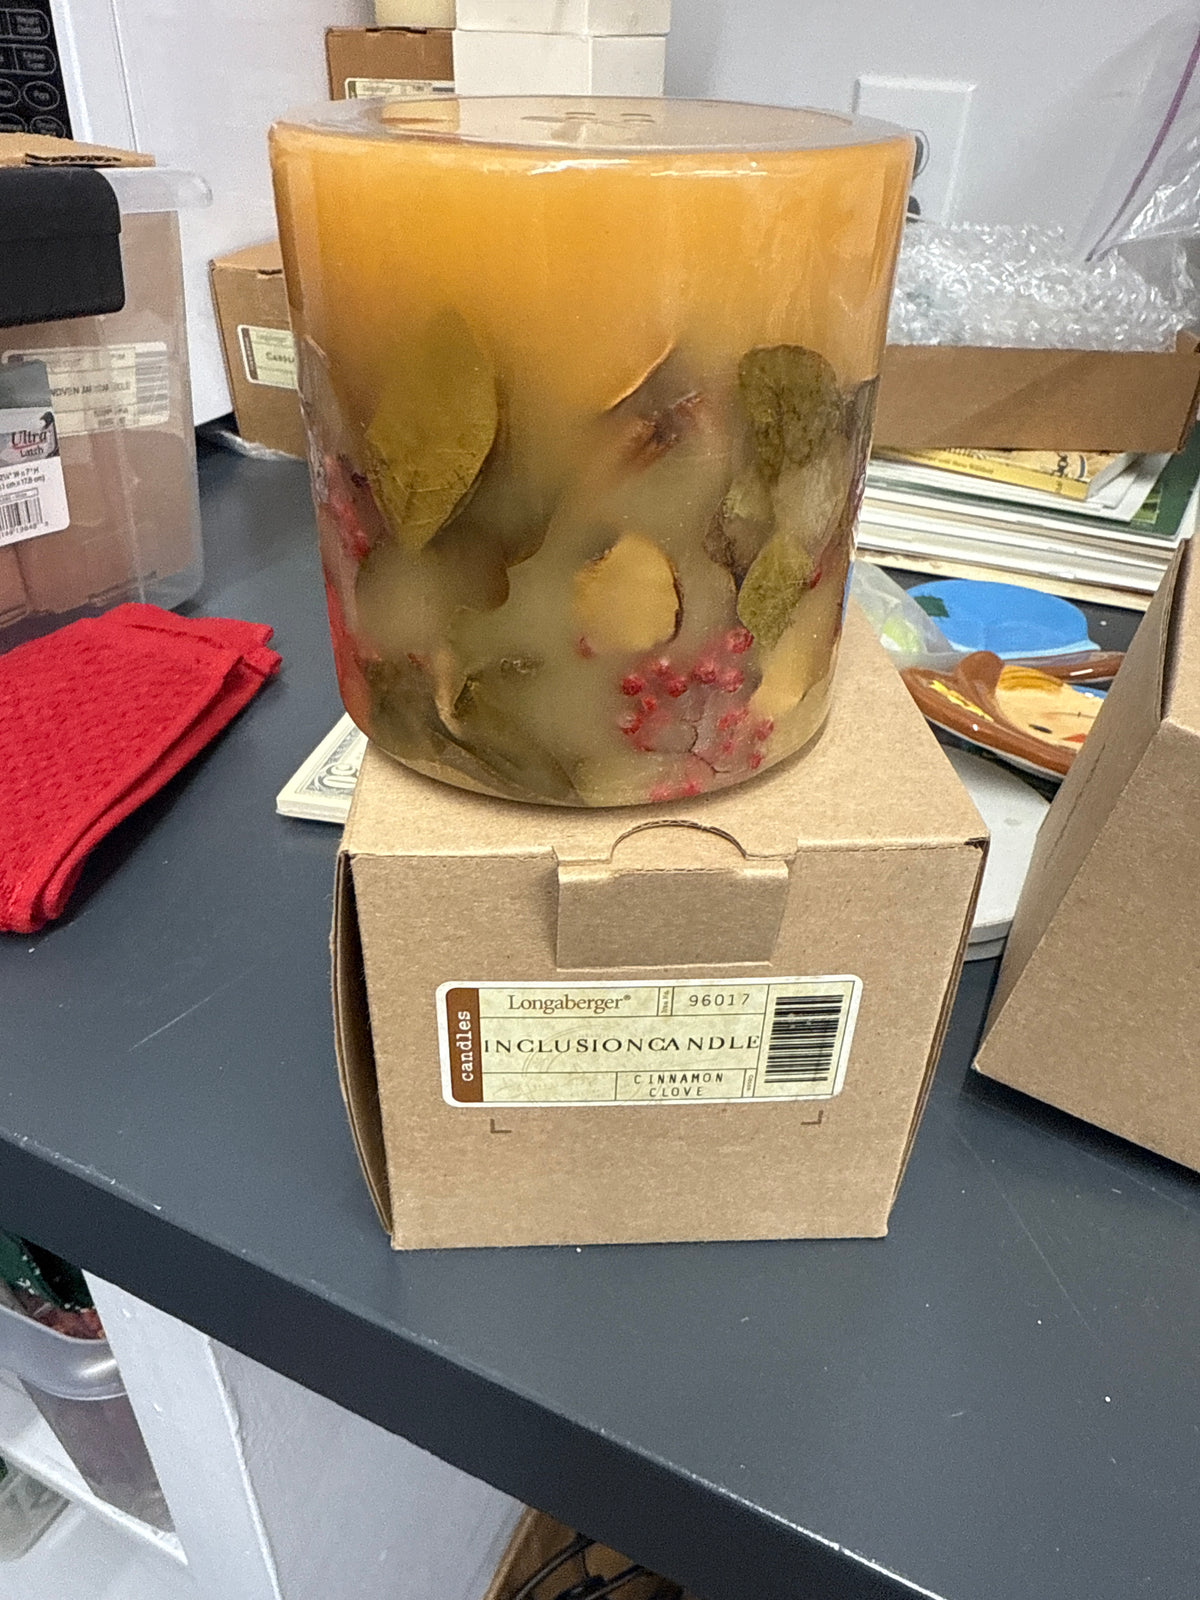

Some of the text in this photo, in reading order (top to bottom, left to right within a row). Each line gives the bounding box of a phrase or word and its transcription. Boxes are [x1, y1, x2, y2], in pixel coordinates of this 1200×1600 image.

[11, 430, 47, 446] Ultra
[20, 446, 44, 458] Latch
[689, 993, 750, 1007] 96017
[455, 1010, 475, 1082] candles
[634, 1072, 723, 1085] CINNAMON
[649, 1086, 703, 1098] CLOVE
